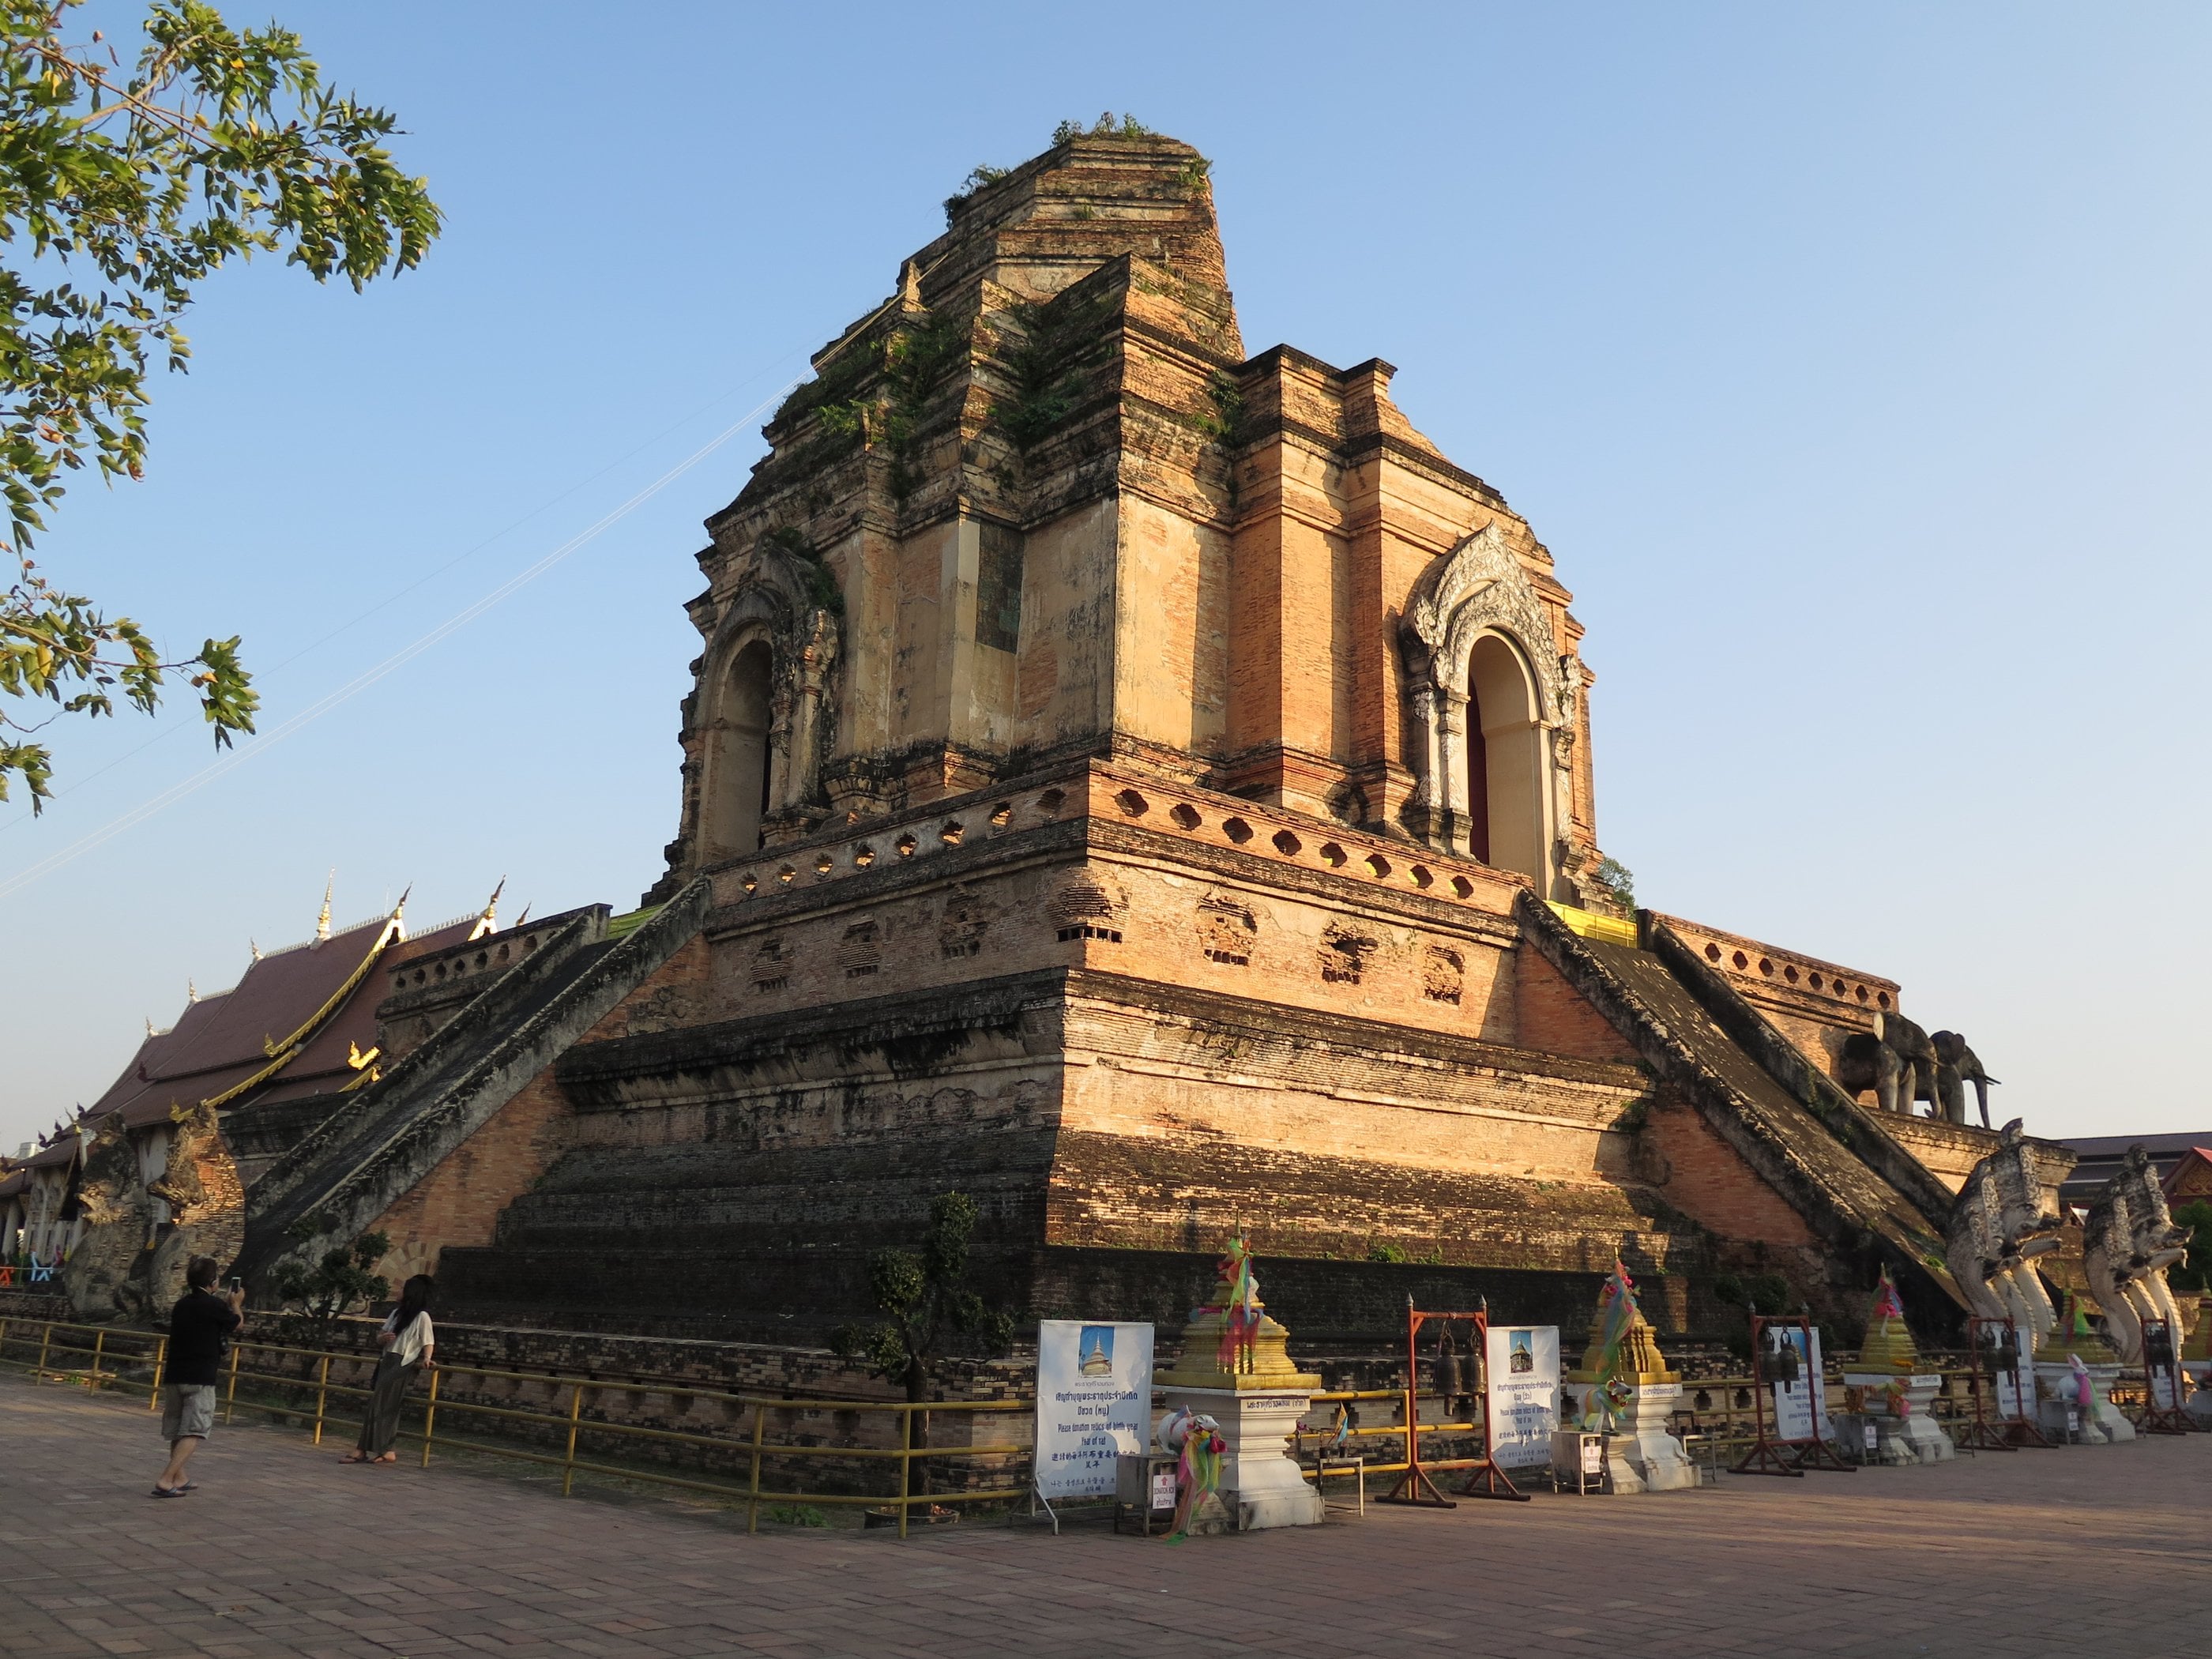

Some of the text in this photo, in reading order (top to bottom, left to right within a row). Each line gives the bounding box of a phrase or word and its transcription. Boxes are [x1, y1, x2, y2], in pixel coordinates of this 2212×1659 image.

[1095, 1404, 1109, 1416] (หนู)
[1058, 1421, 1138, 1432] Please donation relics of birth year
[1092, 1436, 1097, 1445] of
